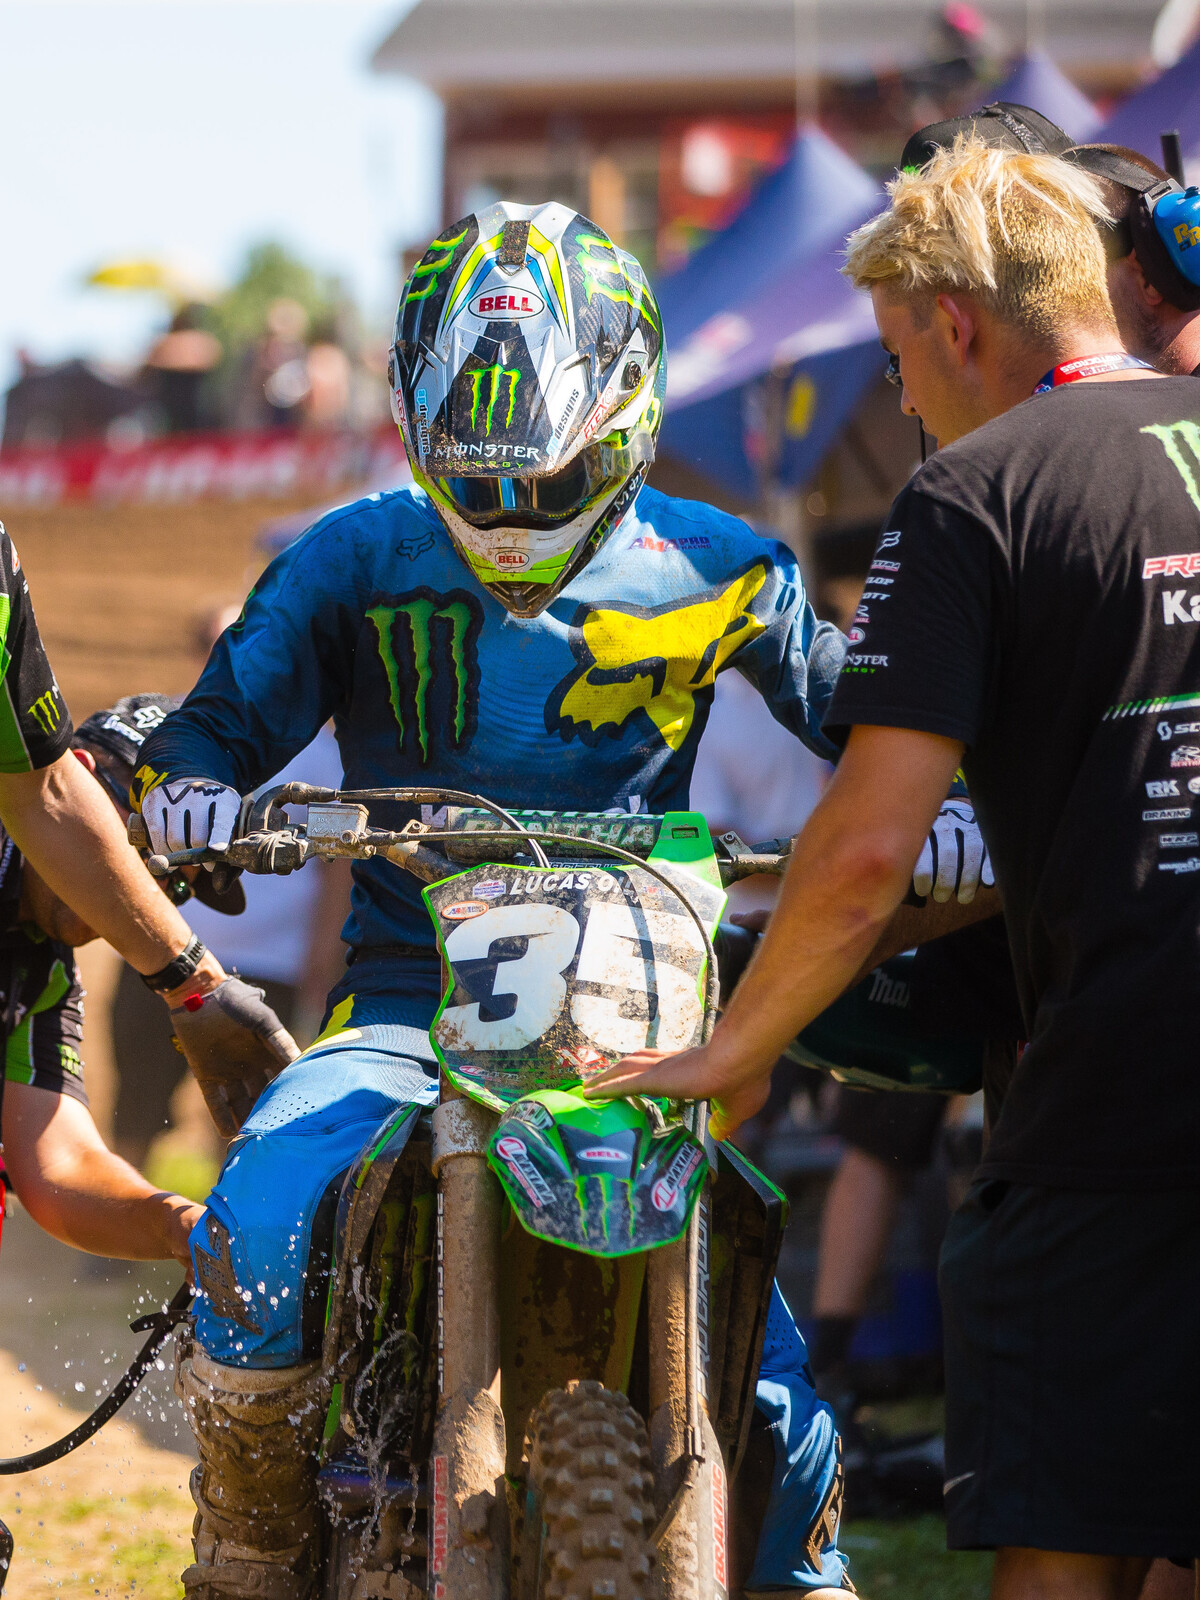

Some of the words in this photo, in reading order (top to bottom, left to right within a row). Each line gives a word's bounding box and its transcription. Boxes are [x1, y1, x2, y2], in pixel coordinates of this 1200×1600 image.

[479, 295, 533, 312] BELL
[435, 441, 541, 462] MONSTER
[627, 536, 679, 552] AMA
[498, 555, 525, 564] BELL
[1145, 780, 1180, 796] RK
[1144, 808, 1191, 820] BRAKING
[509, 873, 592, 896] LUCAS
[598, 875, 635, 896] OIL
[439, 902, 704, 1055] 35
[585, 1150, 625, 1160] BELL
[664, 1140, 698, 1190] MAXIMA
[712, 1463, 726, 1586] BRAKING
